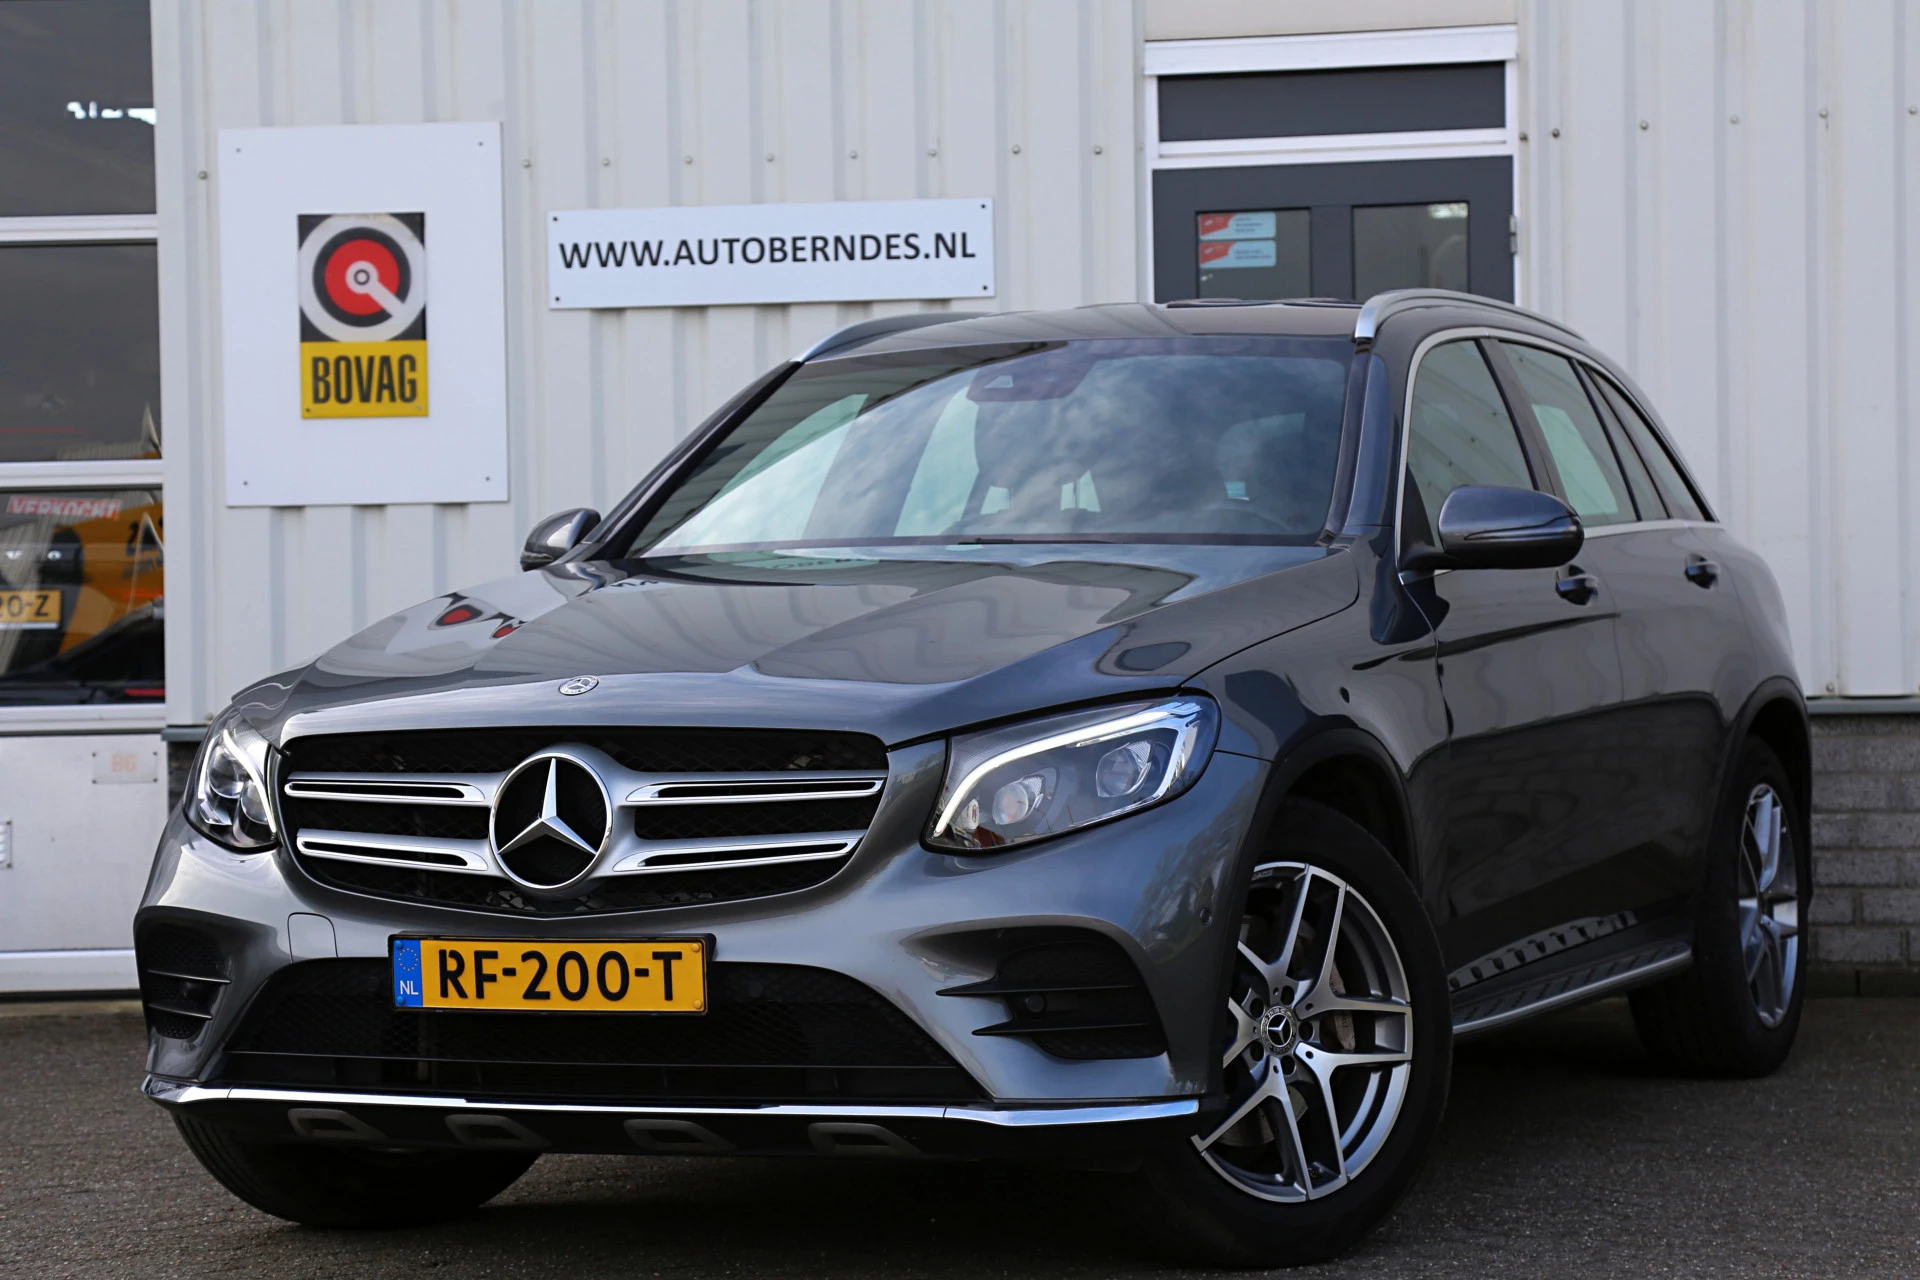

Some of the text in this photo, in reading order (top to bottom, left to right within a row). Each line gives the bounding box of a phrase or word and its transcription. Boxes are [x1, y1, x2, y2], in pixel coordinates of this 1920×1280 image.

[559, 232, 976, 269] WWW.AUTOBERNDES.NL
[311, 354, 417, 404] BOVAG
[0, 595, 49, 617] 0-Z
[400, 980, 419, 995] NL
[438, 948, 683, 1001] RF-200-T
